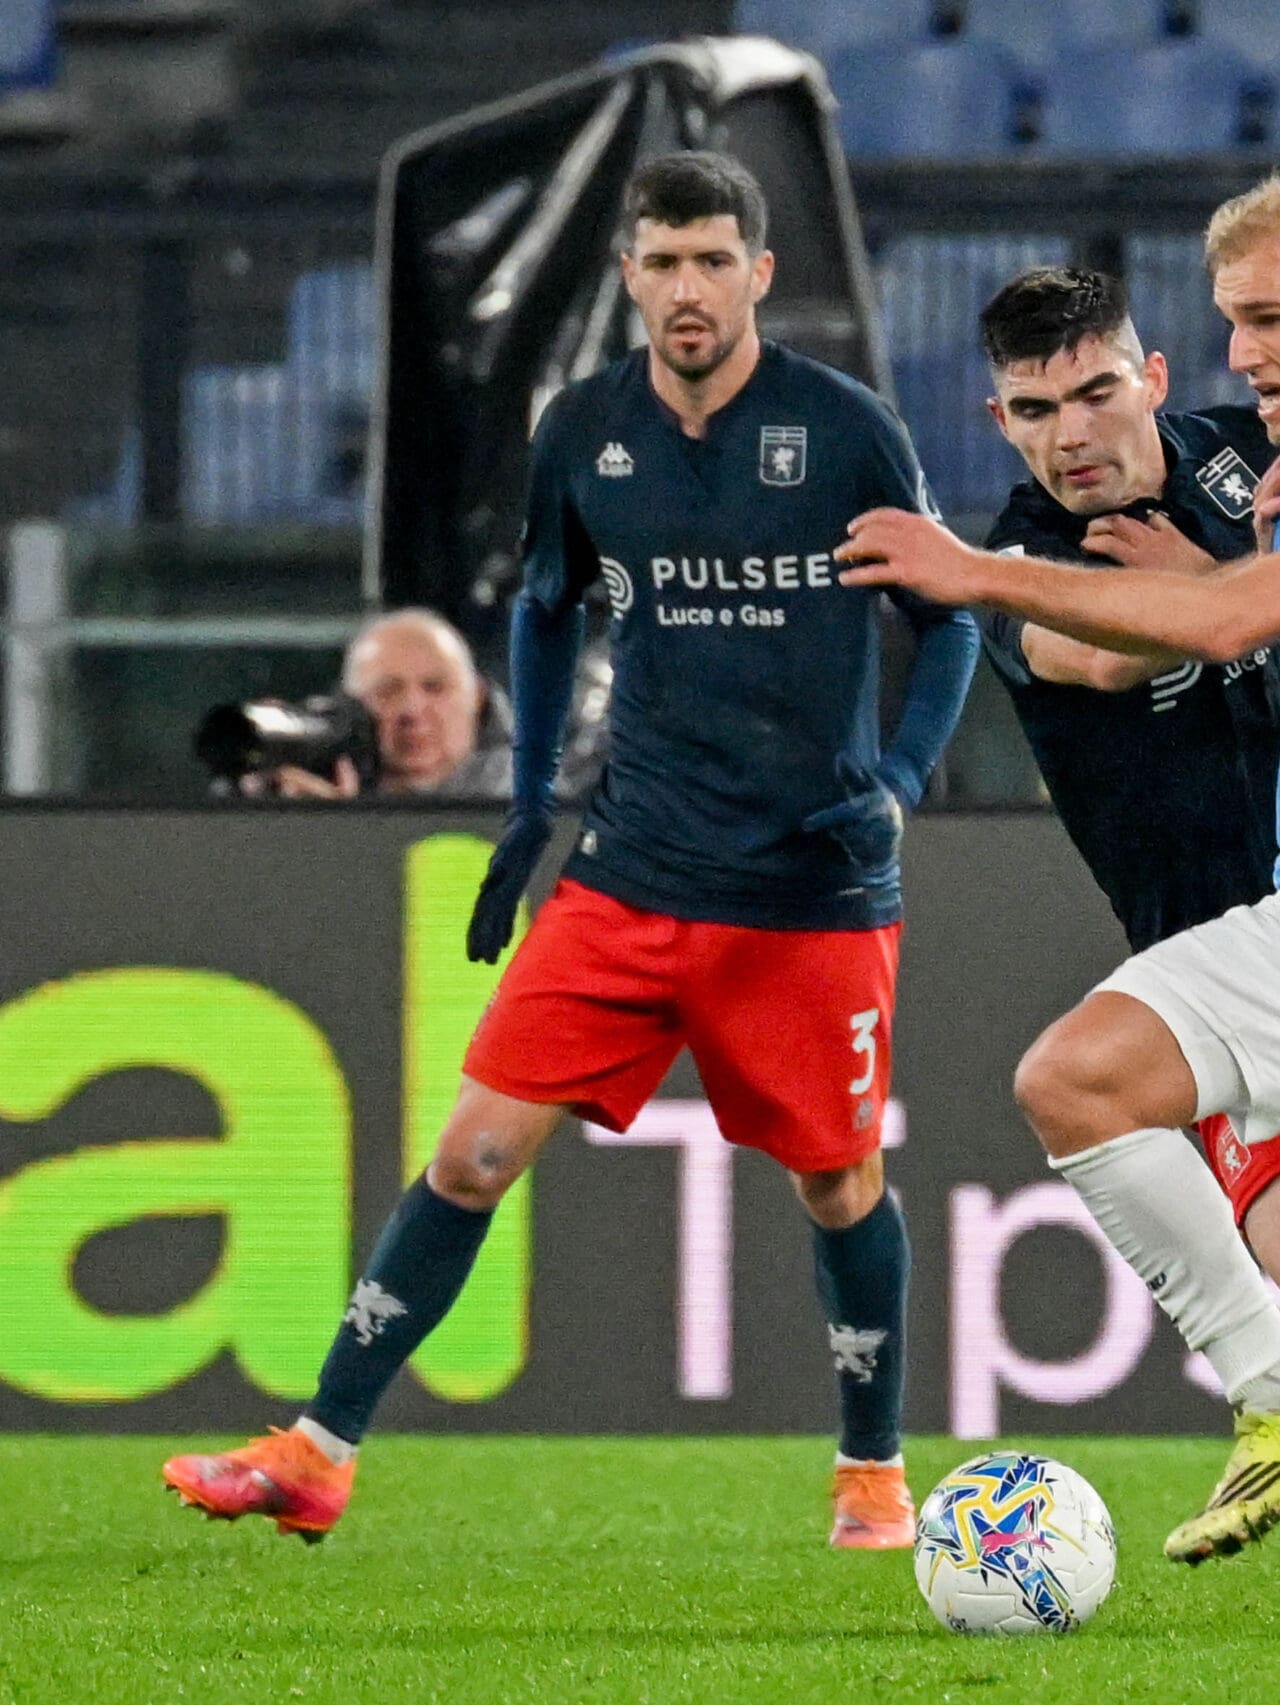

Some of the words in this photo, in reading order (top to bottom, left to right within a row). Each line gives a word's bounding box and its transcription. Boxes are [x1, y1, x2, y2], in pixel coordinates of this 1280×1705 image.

[652, 553, 833, 590] PULSEE
[657, 604, 713, 626] Luce
[720, 608, 734, 626] e
[740, 604, 786, 627] Gas
[1223, 648, 1268, 686] uce
[850, 1008, 880, 1095] 3
